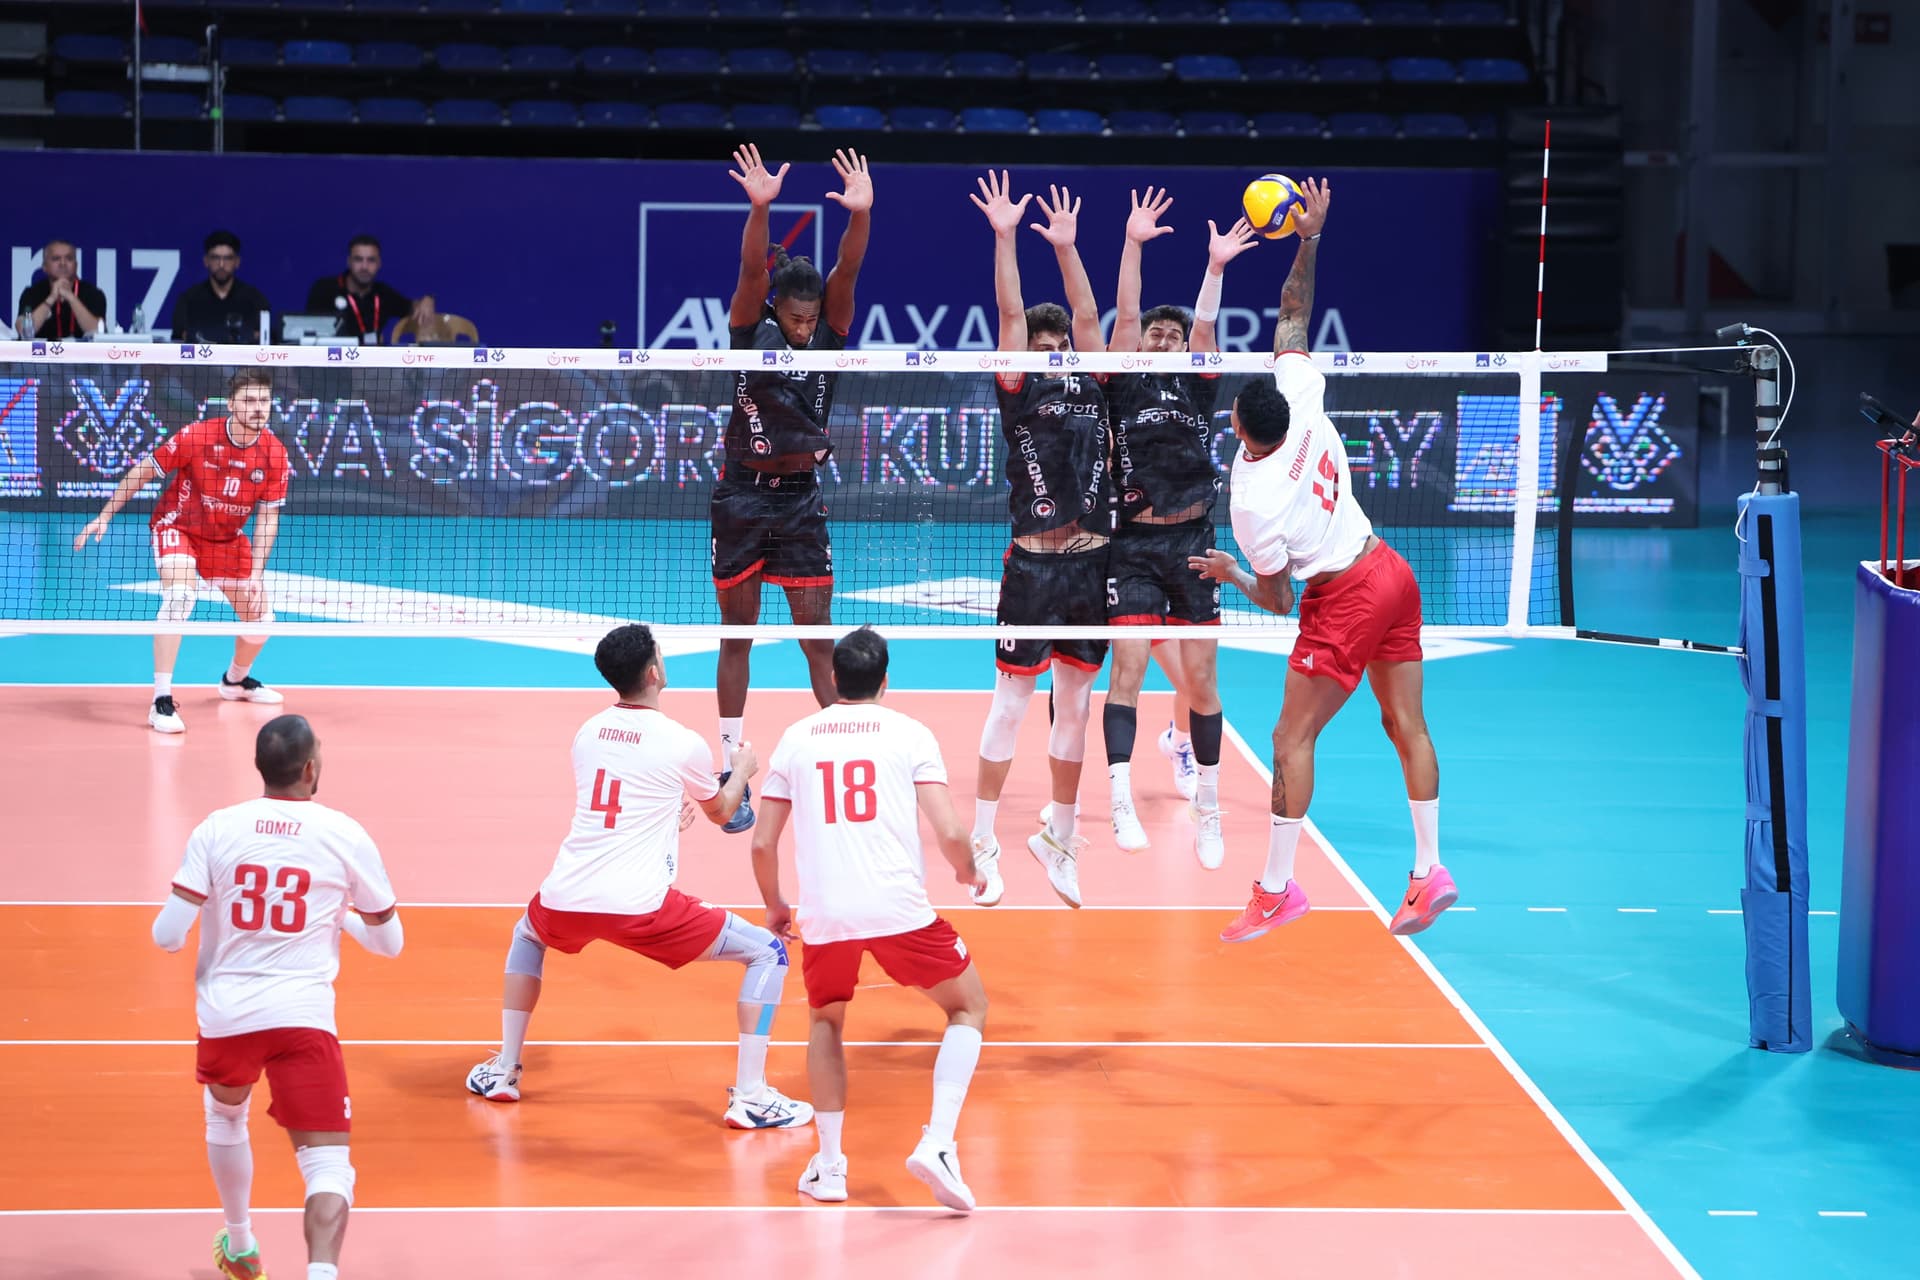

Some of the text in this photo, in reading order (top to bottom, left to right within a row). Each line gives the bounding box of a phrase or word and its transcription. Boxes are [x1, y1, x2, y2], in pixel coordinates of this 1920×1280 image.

[858, 304, 996, 350] AXA
[122, 350, 141, 359] TVF
[270, 352, 289, 361] TVF
[417, 354, 435, 362] TVF
[561, 356, 580, 364] TVF
[707, 357, 724, 365] TVF
[850, 357, 868, 366] TVF
[993, 358, 1011, 367] TVF
[1136, 358, 1153, 367] TVF
[1420, 360, 1440, 368] TVF
[1562, 359, 1581, 367] TVF
[737, 370, 763, 434] ENDGRU
[1014, 424, 1048, 496] ENDGRUP
[222, 476, 241, 497] 10
[160, 528, 180, 549] 10
[598, 727, 642, 745] ATAKAN
[811, 721, 881, 737] HAMACHER
[590, 768, 622, 829] 4
[816, 759, 877, 824] 18
[255, 819, 302, 837] GOMEZ
[231, 863, 311, 934] 33
